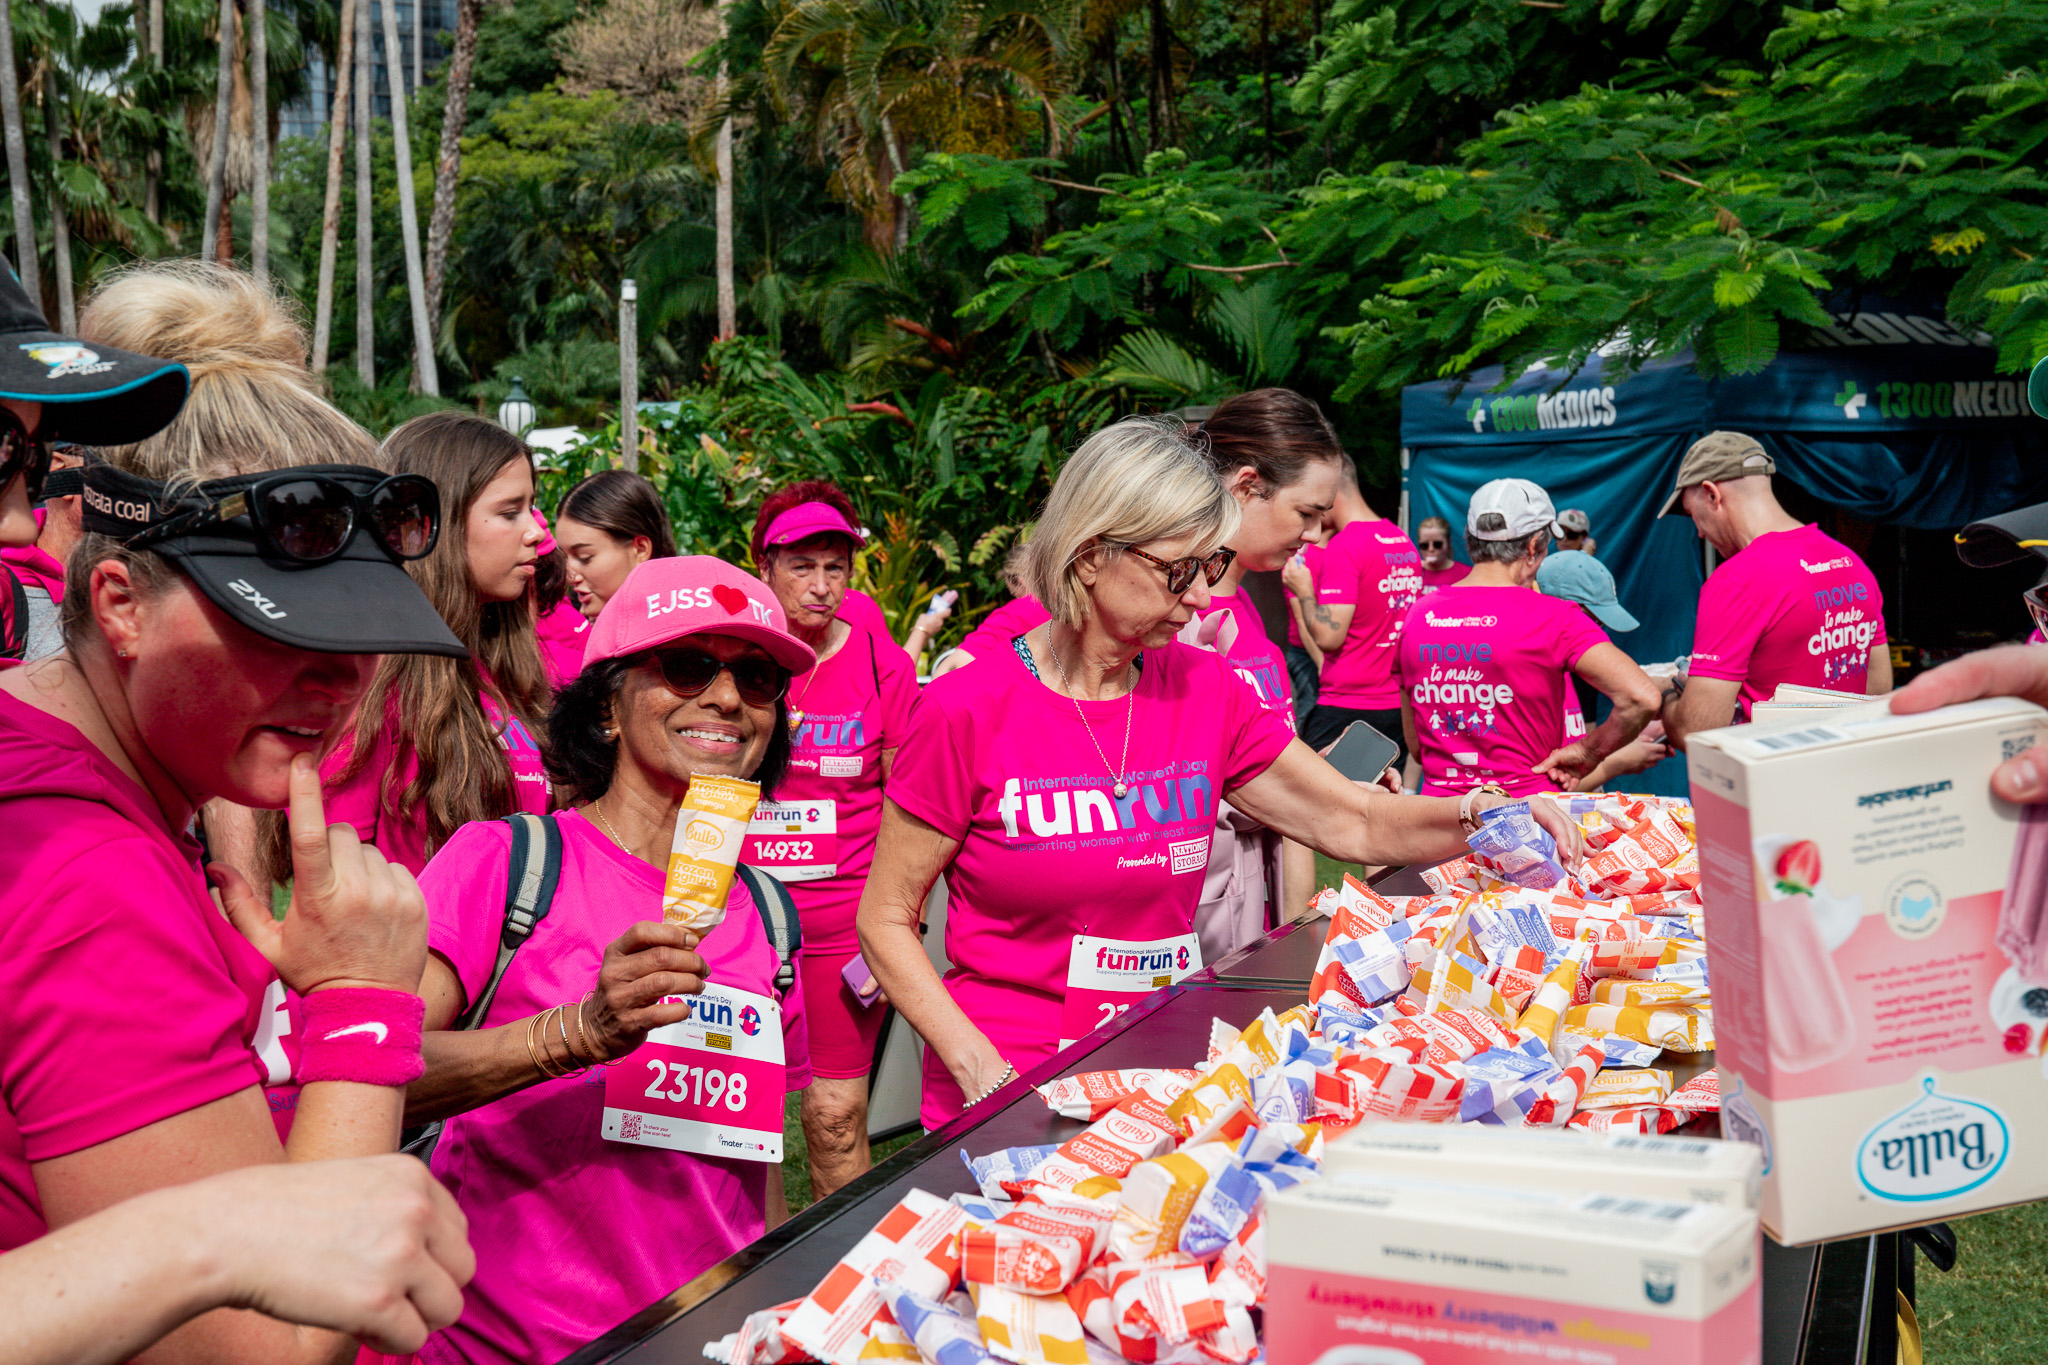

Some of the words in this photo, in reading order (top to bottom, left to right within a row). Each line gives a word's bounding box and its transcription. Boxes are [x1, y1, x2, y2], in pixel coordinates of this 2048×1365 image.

[1876, 380, 2031, 419] 1300MEDI
[114, 500, 151, 523] coal
[1384, 550, 1418, 565] move
[227, 577, 288, 621] 2XU
[646, 586, 713, 620] EJSS
[748, 597, 773, 627] TK
[1813, 582, 1868, 611] move
[1430, 616, 1464, 627] mater
[1824, 609, 1834, 630] to
[1834, 606, 1864, 627] make
[1807, 617, 1878, 656] change
[1419, 643, 1492, 663] move
[1430, 663, 1443, 682] to
[1444, 665, 1484, 683] make
[1413, 676, 1514, 710] change
[803, 712, 847, 722] Women's
[1023, 772, 1118, 791] International
[1122, 761, 1181, 783] Women's
[1182, 760, 1208, 774] Day
[692, 780, 735, 795] frozen
[693, 798, 726, 810] mango
[751, 808, 801, 822] unrun
[997, 774, 1212, 838] funrun
[686, 825, 719, 846] Bulla
[1004, 838, 1077, 854] Supporting
[1080, 835, 1124, 848] women
[1127, 830, 1152, 843] with
[1153, 825, 1186, 840] breast
[753, 841, 814, 861] 14932
[1627, 847, 1647, 868] Bulla
[1641, 832, 1673, 862] yoghurt
[1117, 855, 1155, 869] Presented
[1155, 853, 1169, 867] by
[671, 885, 703, 897] mango
[672, 871, 718, 890] oghurt
[1359, 901, 1386, 923] Bulla
[1096, 946, 1173, 971] funrun
[1108, 947, 1145, 955] International
[720, 996, 732, 1006] Day
[644, 1058, 748, 1112] 23198
[1114, 1119, 1151, 1141] Bulla
[721, 1139, 743, 1148] mater
[1083, 1134, 1136, 1162] strawberry
[1877, 1122, 1995, 1178] Bulla
[1070, 1140, 1131, 1172] yoghurt
[1051, 1168, 1078, 1186] ulla
[1306, 1283, 1436, 1321] strawberry
[1441, 1301, 1559, 1337] wildberry
